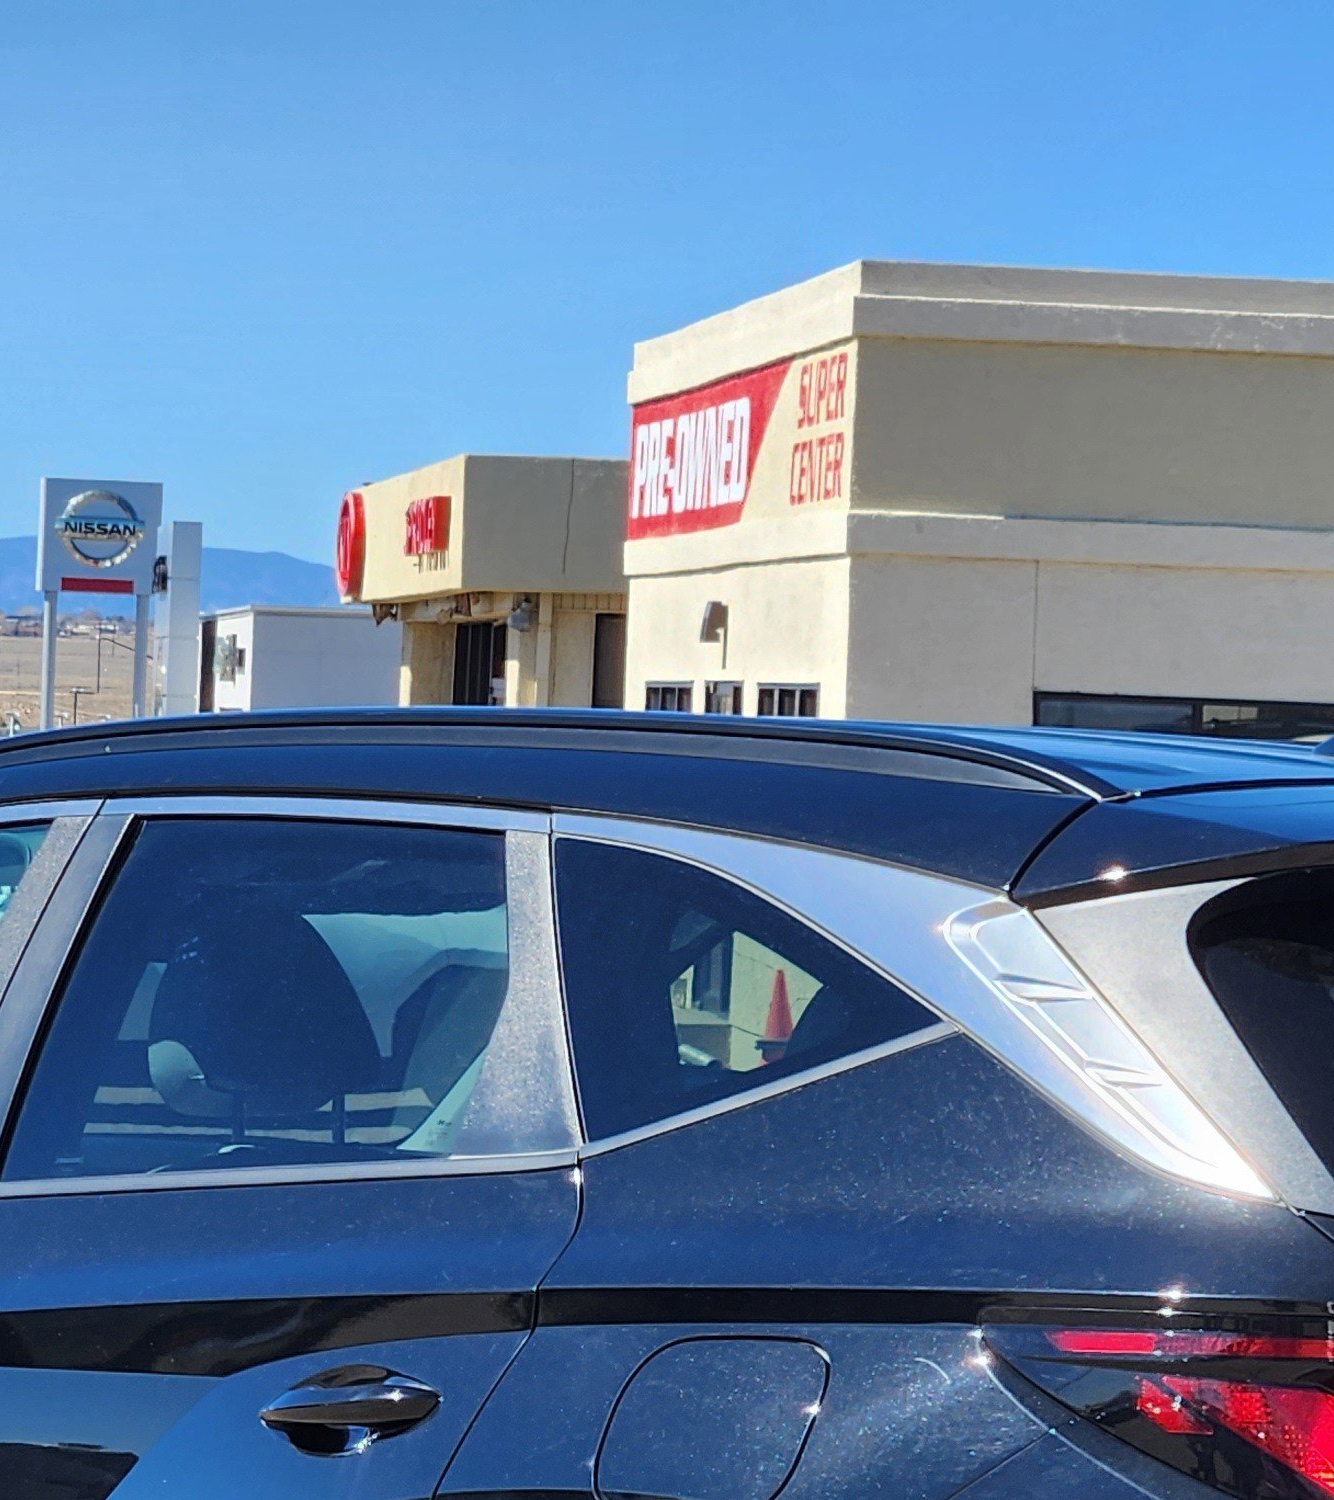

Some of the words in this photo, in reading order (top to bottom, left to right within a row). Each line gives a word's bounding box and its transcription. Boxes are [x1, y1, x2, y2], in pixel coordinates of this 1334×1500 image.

[797, 352, 848, 429] SUPER
[631, 396, 750, 519] PRE-OWNED
[789, 432, 845, 506] CENTER
[64, 521, 136, 536] NISSAN
